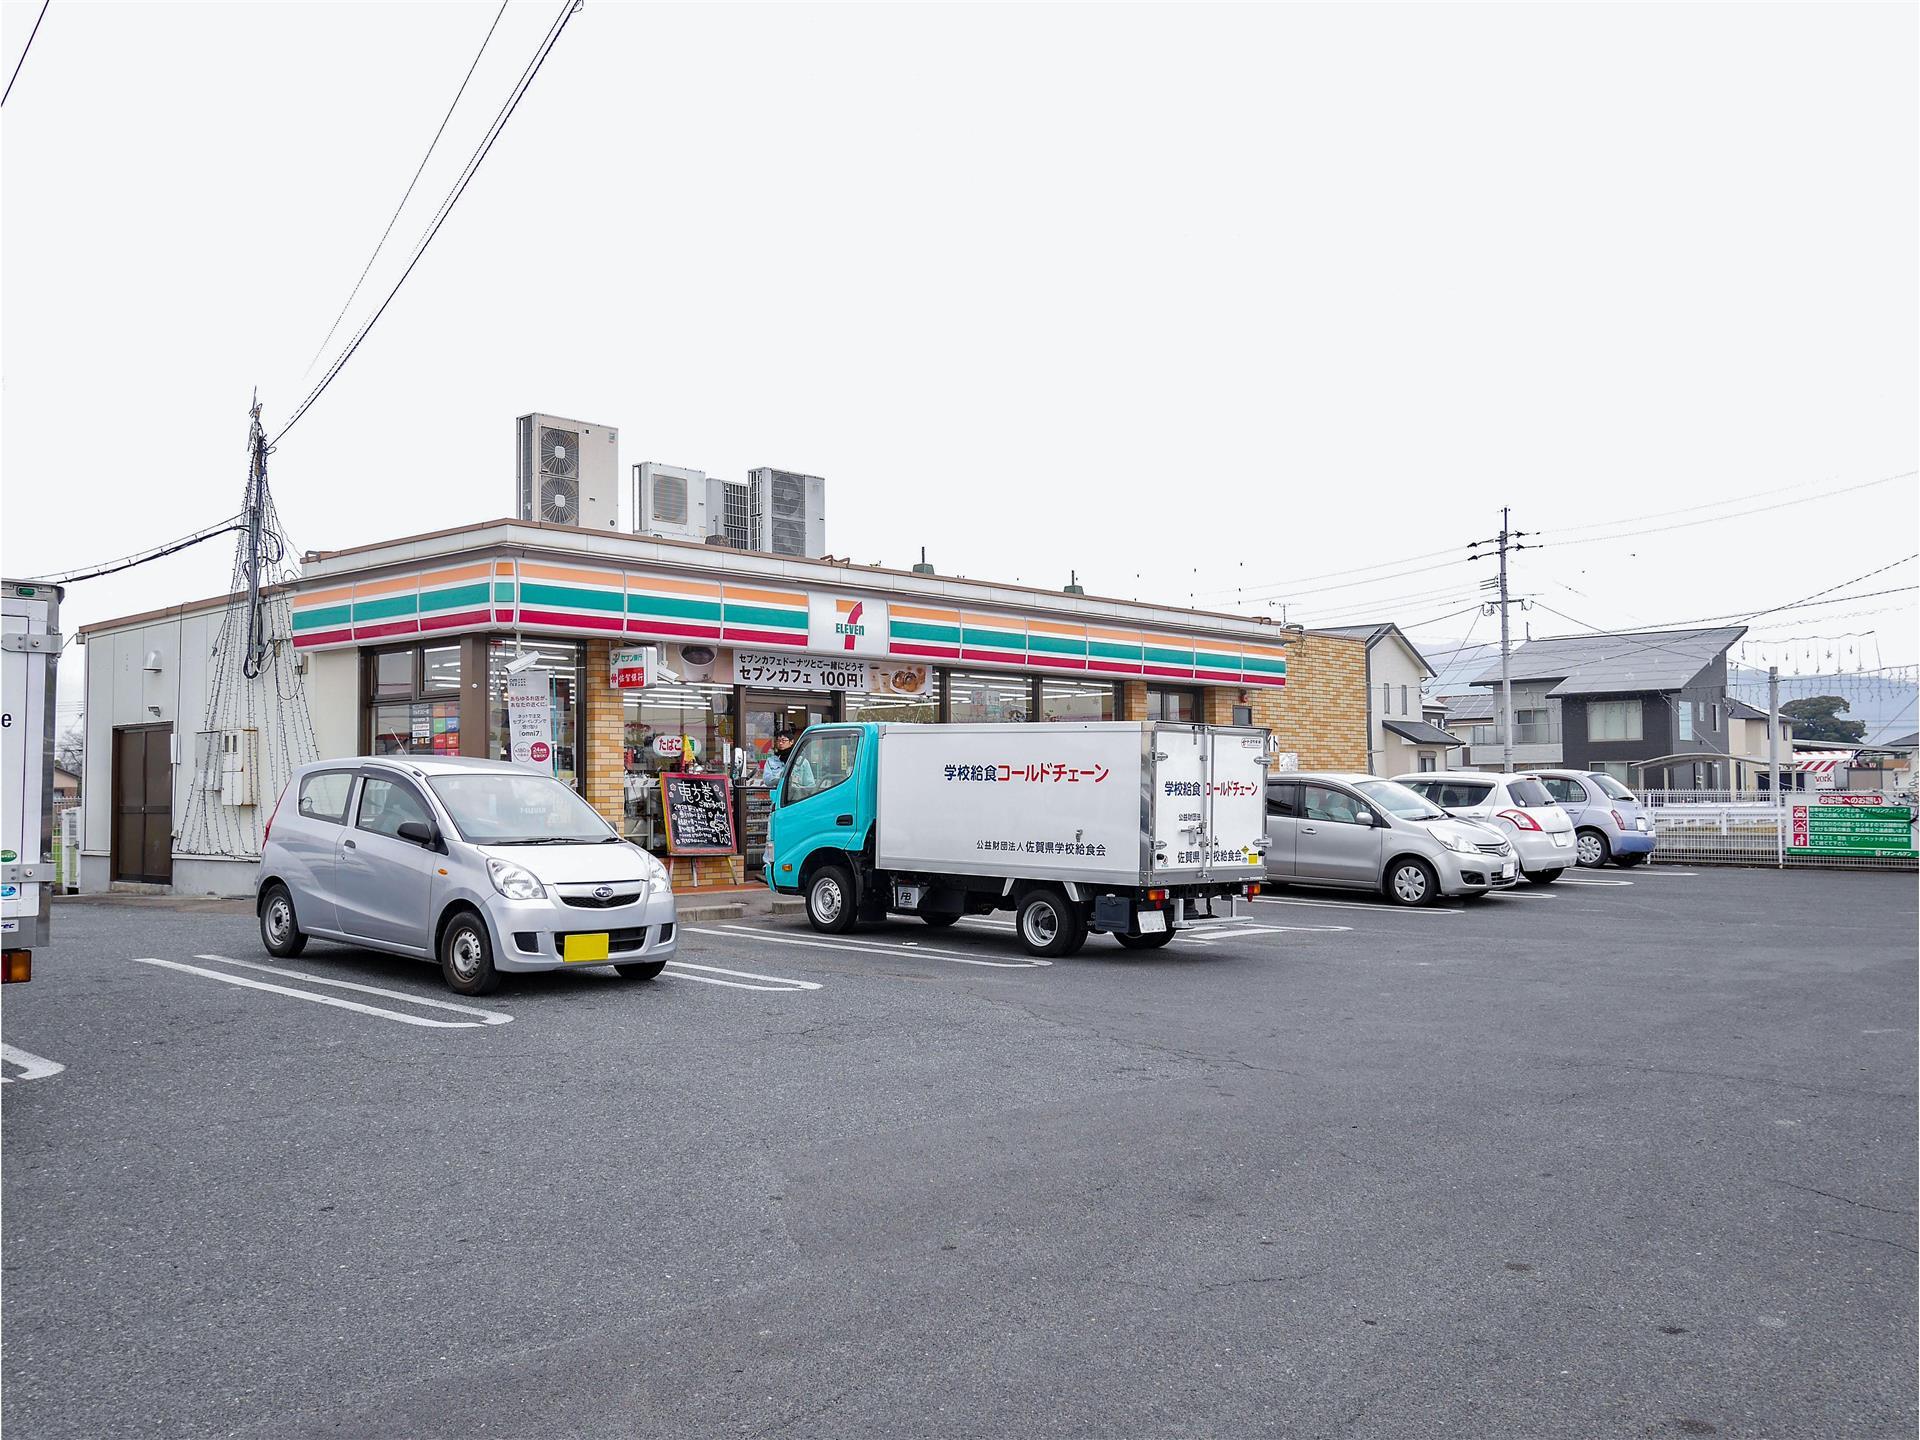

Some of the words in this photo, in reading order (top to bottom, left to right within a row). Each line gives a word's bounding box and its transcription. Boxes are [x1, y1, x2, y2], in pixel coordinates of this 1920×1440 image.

[739, 654, 864, 672] セブンカフェドーナツとご一緒にどうぞ
[739, 665, 812, 684] セブンカフェ
[659, 739, 681, 751] たばこ
[944, 763, 1109, 782] 学校給食コールドチェーン
